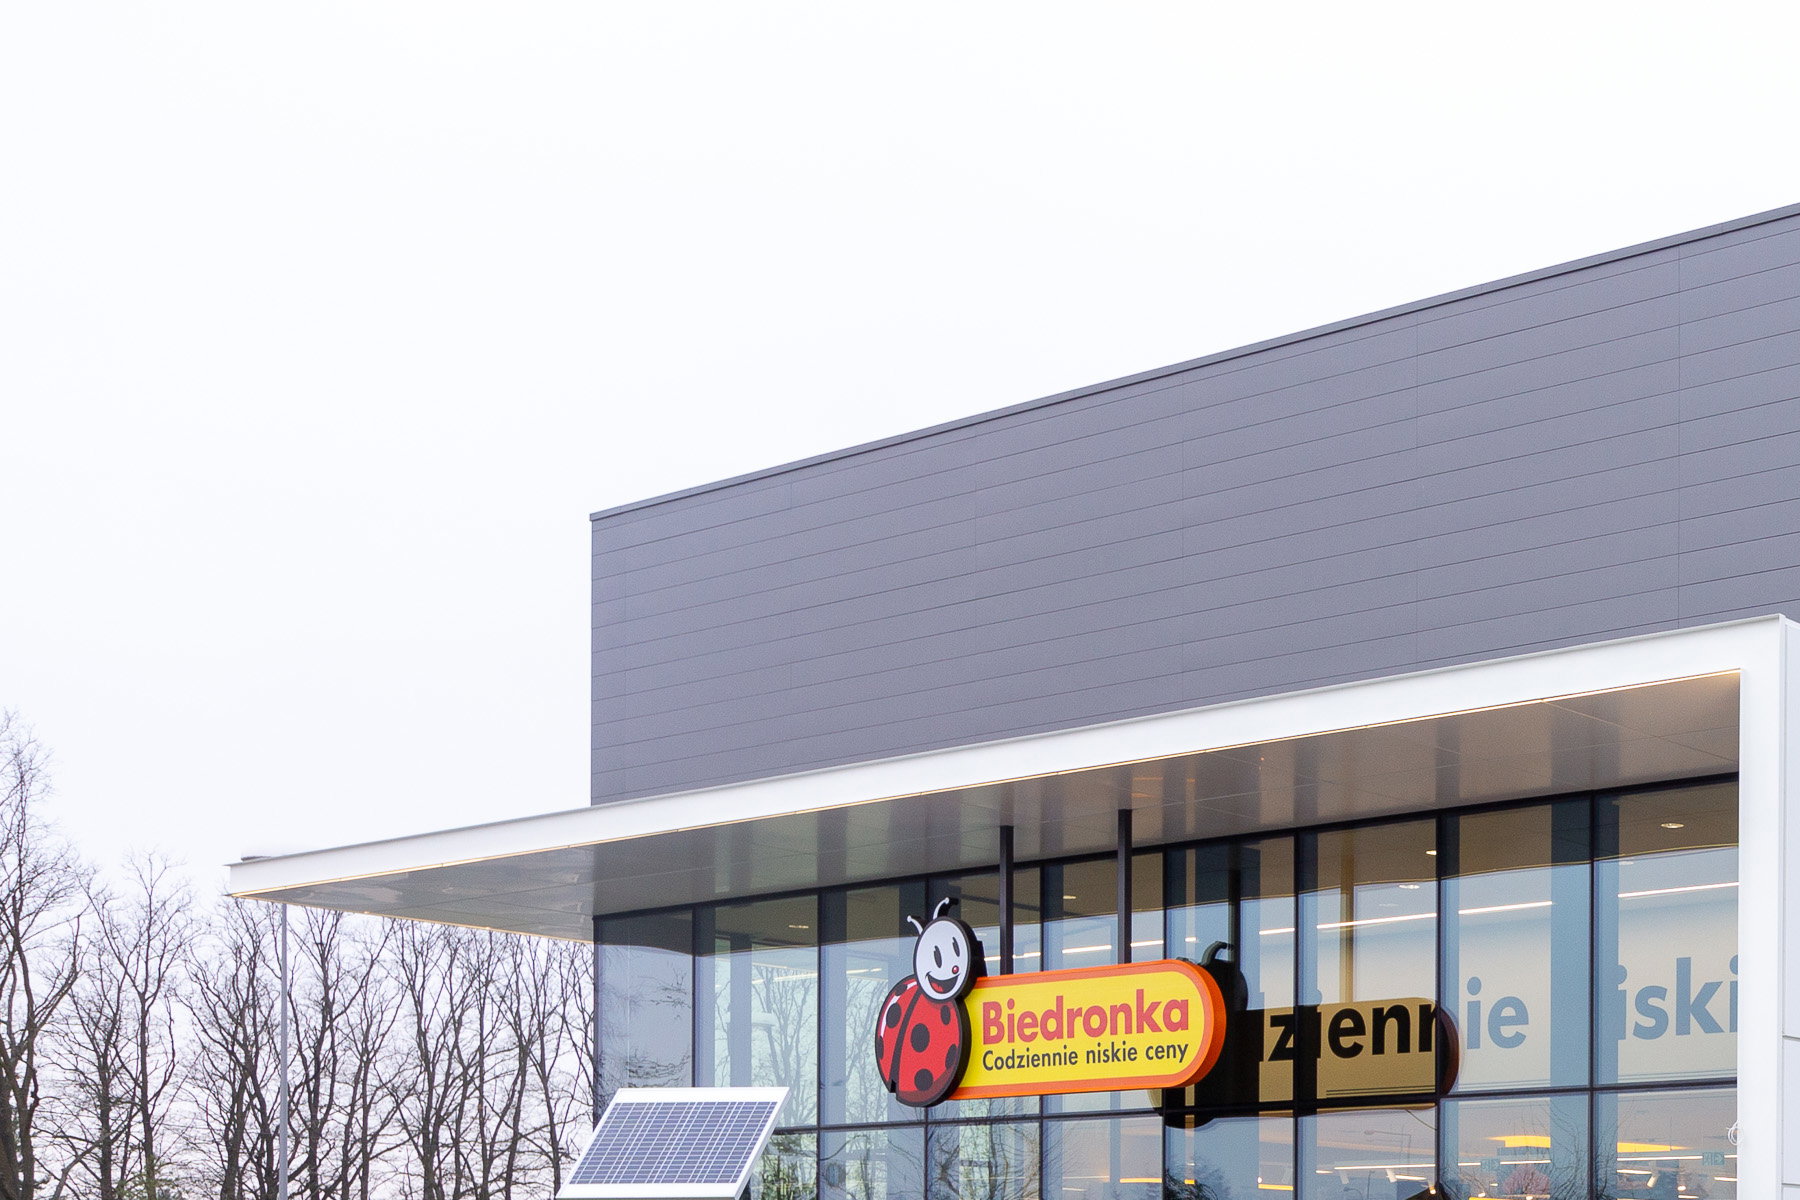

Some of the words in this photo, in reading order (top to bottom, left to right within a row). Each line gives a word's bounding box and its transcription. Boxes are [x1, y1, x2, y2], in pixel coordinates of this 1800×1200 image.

[982, 989, 1189, 1046] Biedronka
[983, 1045, 1078, 1071] Codziennie
[1086, 1040, 1138, 1064] niskie
[1145, 1043, 1189, 1064] ceny
